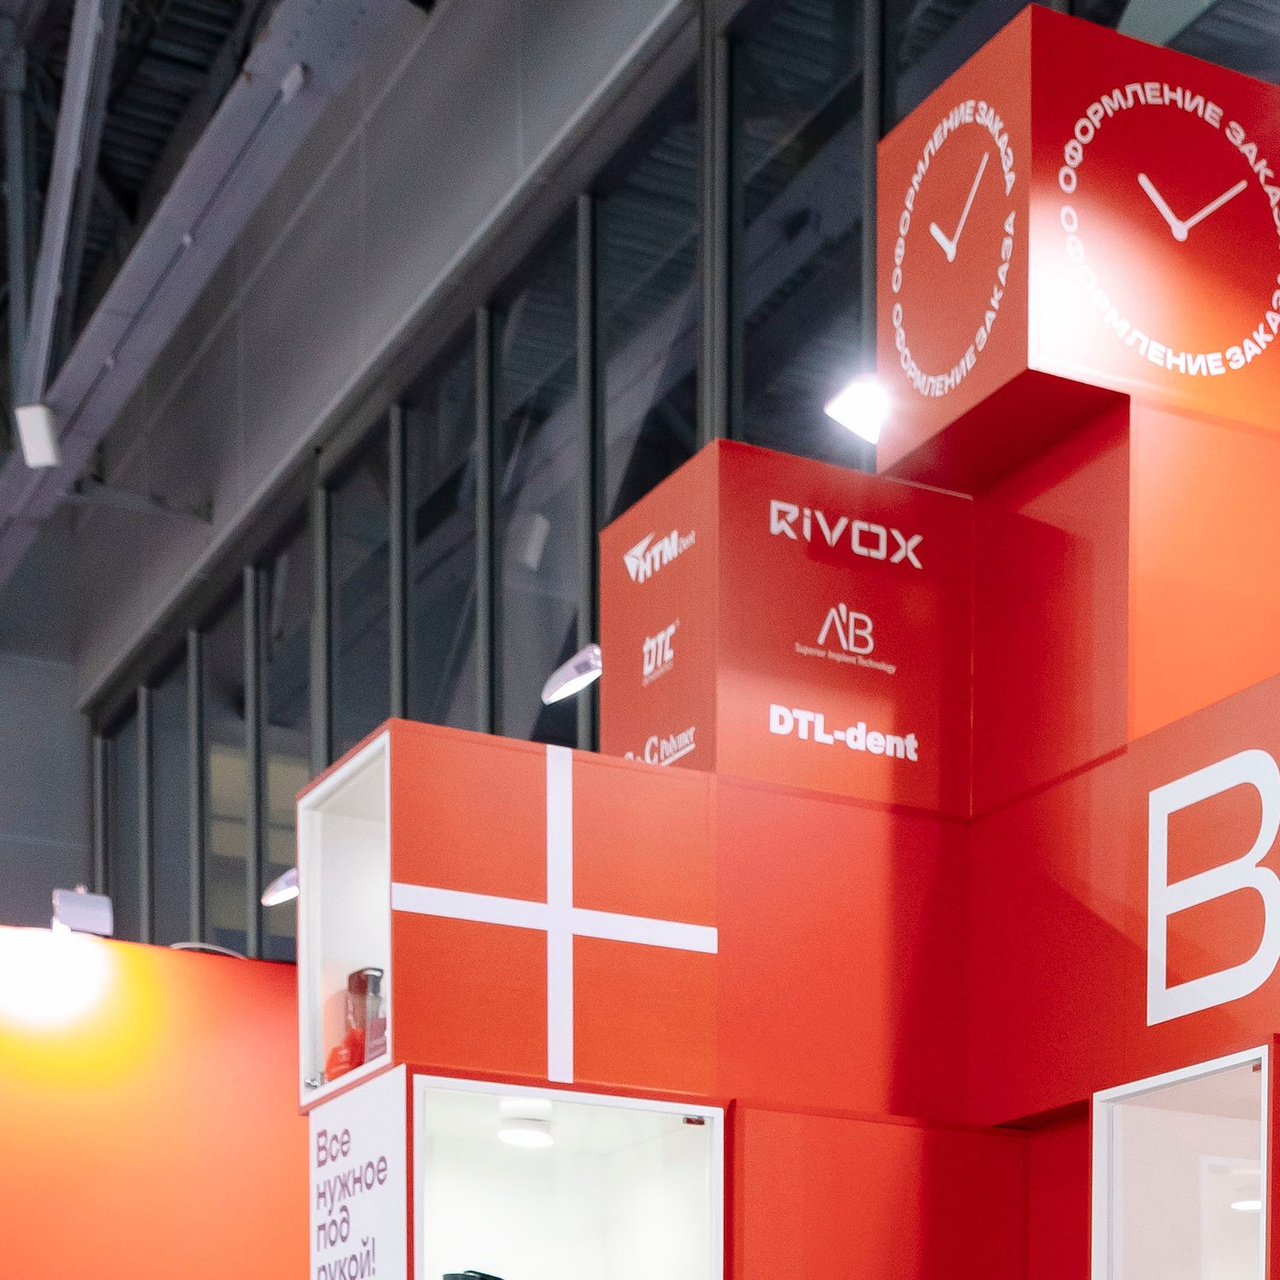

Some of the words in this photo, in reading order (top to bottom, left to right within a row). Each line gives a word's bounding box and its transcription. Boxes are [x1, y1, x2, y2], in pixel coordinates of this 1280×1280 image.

[1058, 82, 1224, 193] ОФОРМЛЕНИЕ
[891, 99, 975, 294] ОФОРМЛЕНИЕ
[973, 100, 1016, 197] ЗАКАЗА
[974, 211, 1016, 352] ЗАКАЗА
[1059, 205, 1227, 377] ОФОРМЛЕНИЕ
[769, 703, 919, 762] DTL-dent
[316, 1128, 351, 1168] Все
[316, 1155, 388, 1215] нужное
[316, 1204, 351, 1252] под
